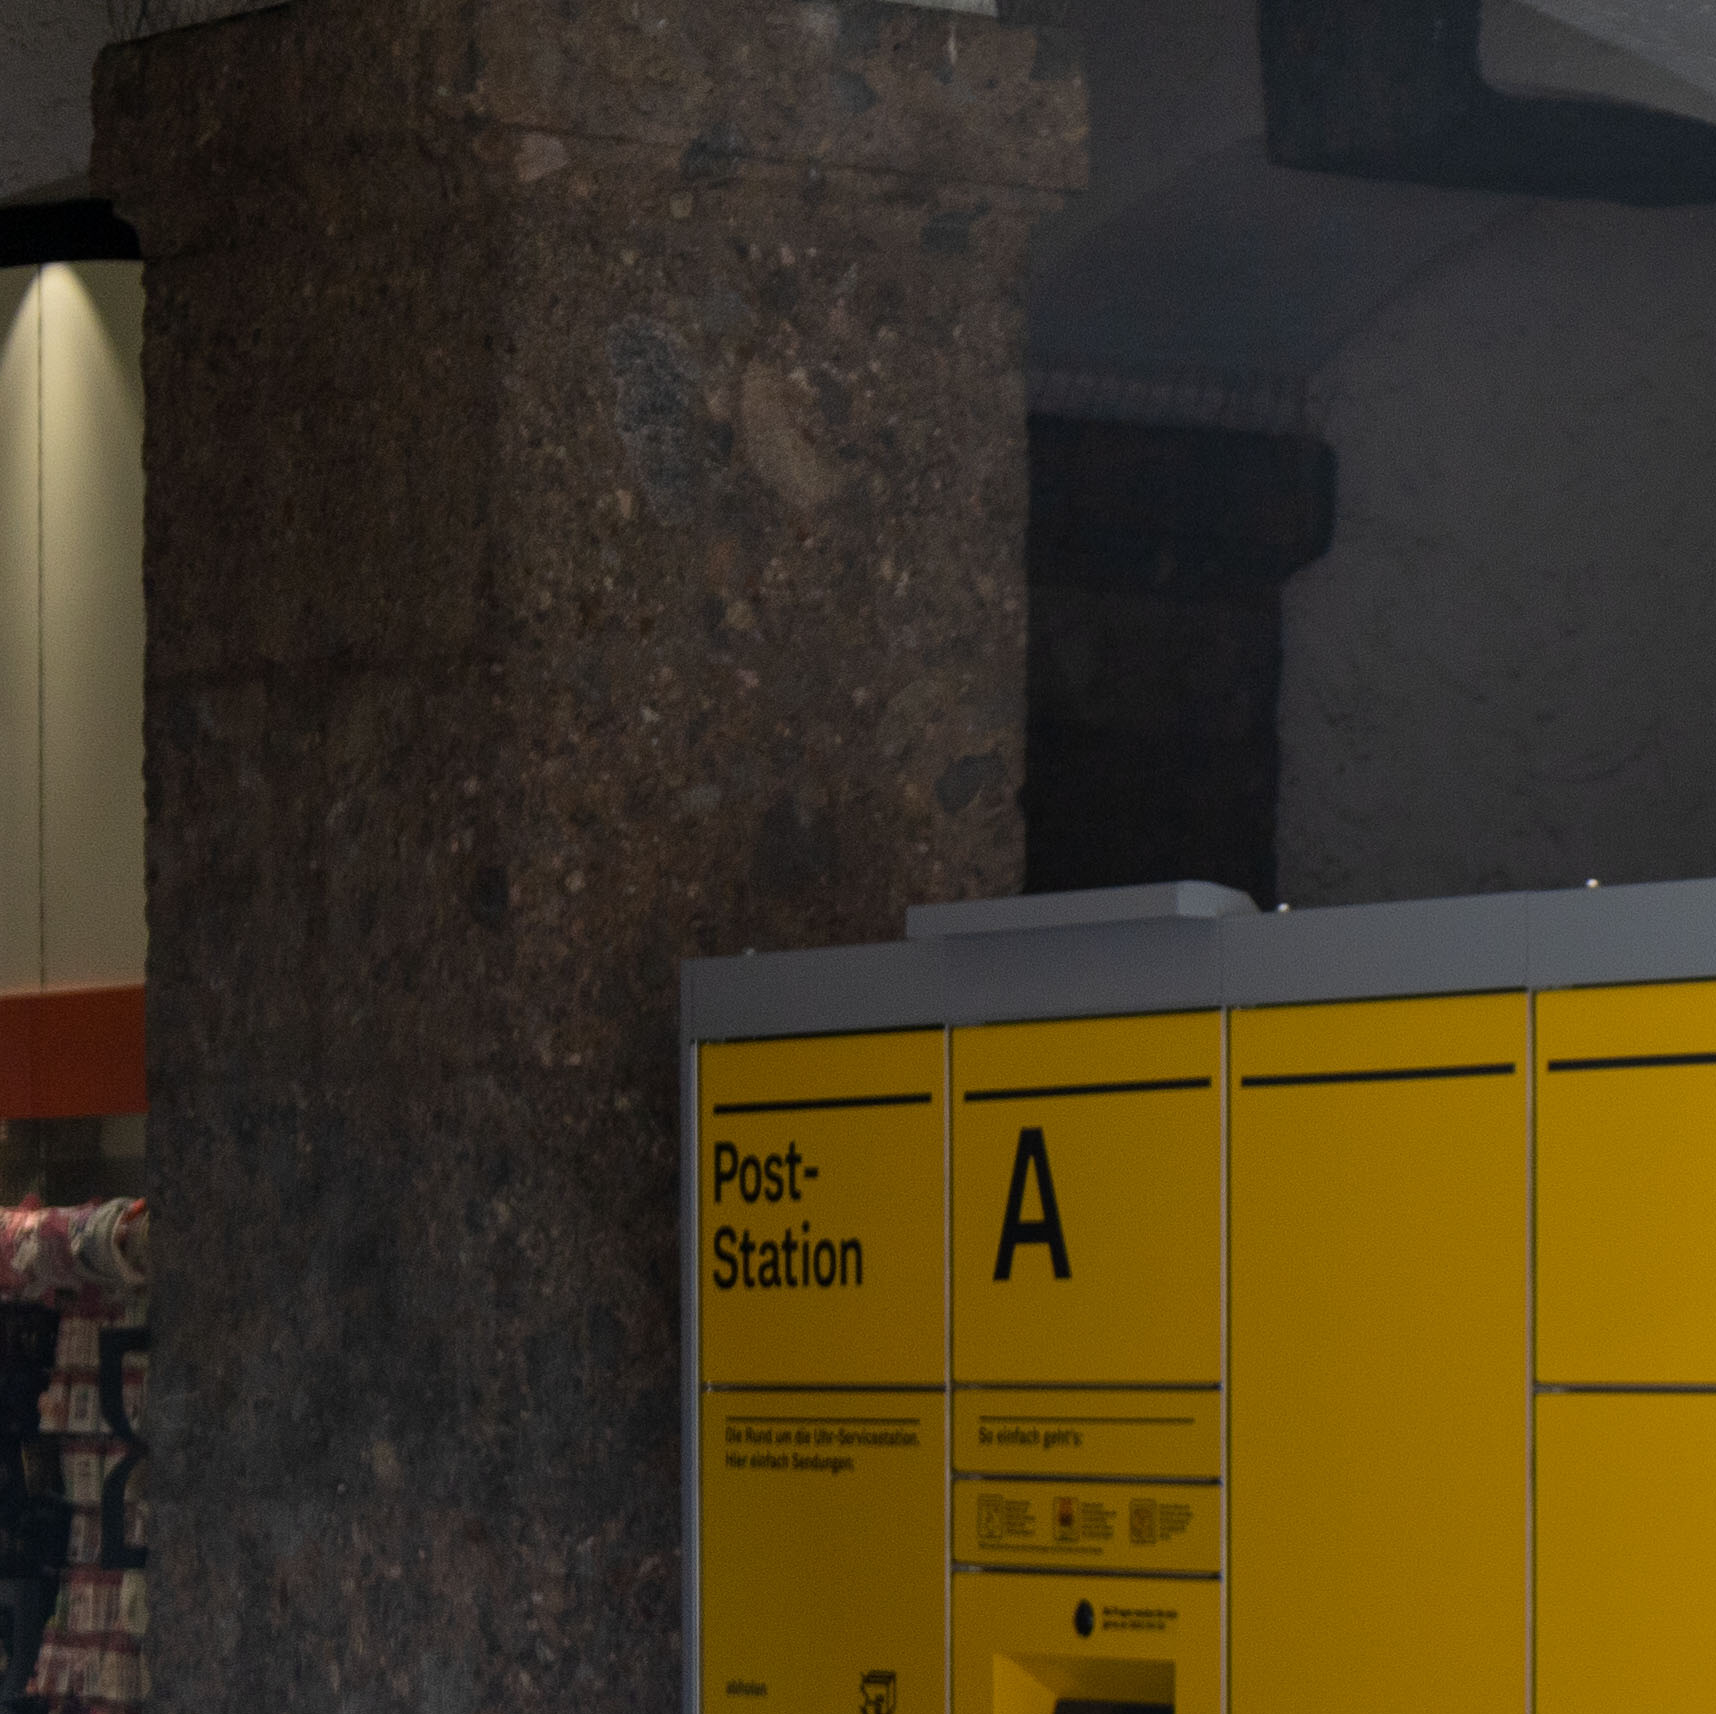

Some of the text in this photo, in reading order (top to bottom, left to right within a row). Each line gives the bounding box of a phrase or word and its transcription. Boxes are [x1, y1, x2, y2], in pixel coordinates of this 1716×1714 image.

[713, 1139, 819, 1204] Post-
[993, 1126, 1072, 1282] A
[713, 1220, 863, 1290] Station
[725, 1426, 742, 1444] Die
[746, 1426, 772, 1444] Rund
[776, 1430, 791, 1444] um
[978, 1426, 993, 1444] So
[997, 1426, 1040, 1445] einfach
[725, 1451, 747, 1468] Hier
[750, 1451, 789, 1469] einfach
